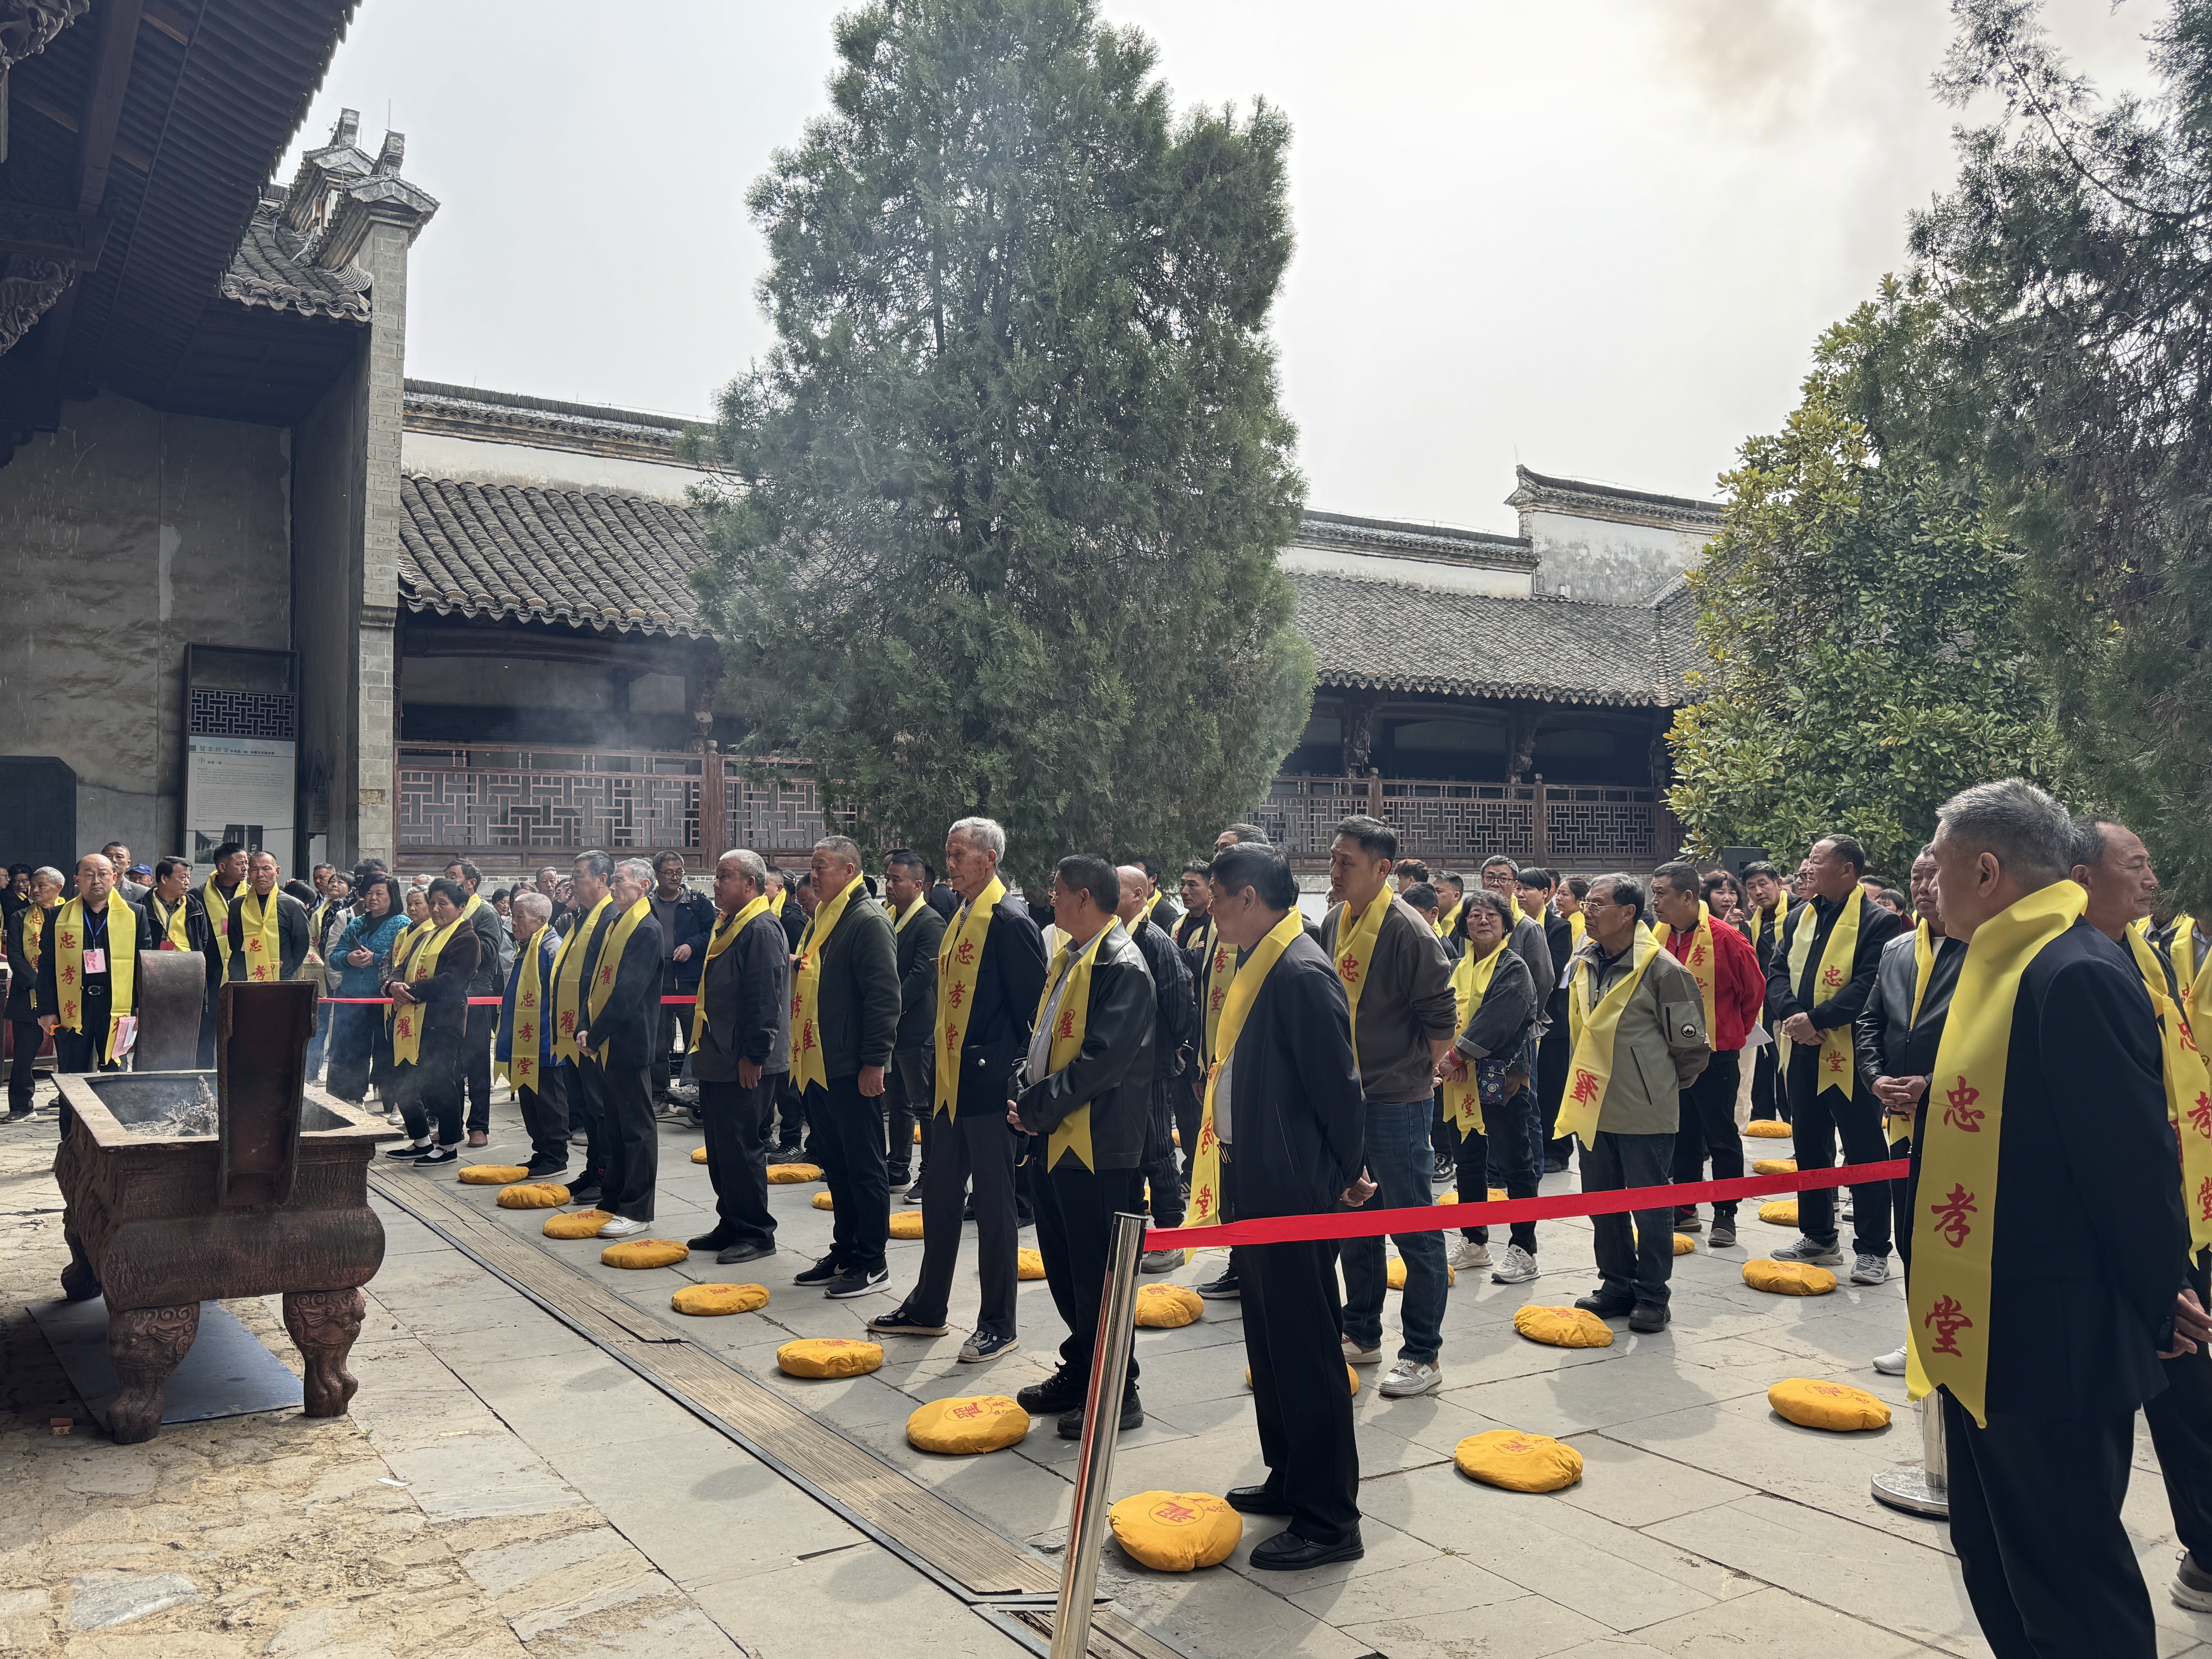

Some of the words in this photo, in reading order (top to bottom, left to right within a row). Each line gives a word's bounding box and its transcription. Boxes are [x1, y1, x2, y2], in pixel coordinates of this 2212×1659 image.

[60, 932, 77, 1019] 忠孝堂
[599, 965, 613, 985] 翟
[1209, 947, 1229, 1011] 孝堂
[1338, 953, 1359, 983] 忠
[945, 937, 975, 1051] 忠孝堂
[397, 1016, 412, 1040] 翟
[517, 989, 535, 1075] 忠孝堂
[560, 1009, 575, 1036] 翟
[1058, 1009, 1076, 1042] 翟
[1461, 1094, 1475, 1118] 堂
[1924, 1075, 1985, 1357] 忠孝堂
[953, 1402, 984, 1419] 翟
[1155, 1502, 1196, 1523] 翟
